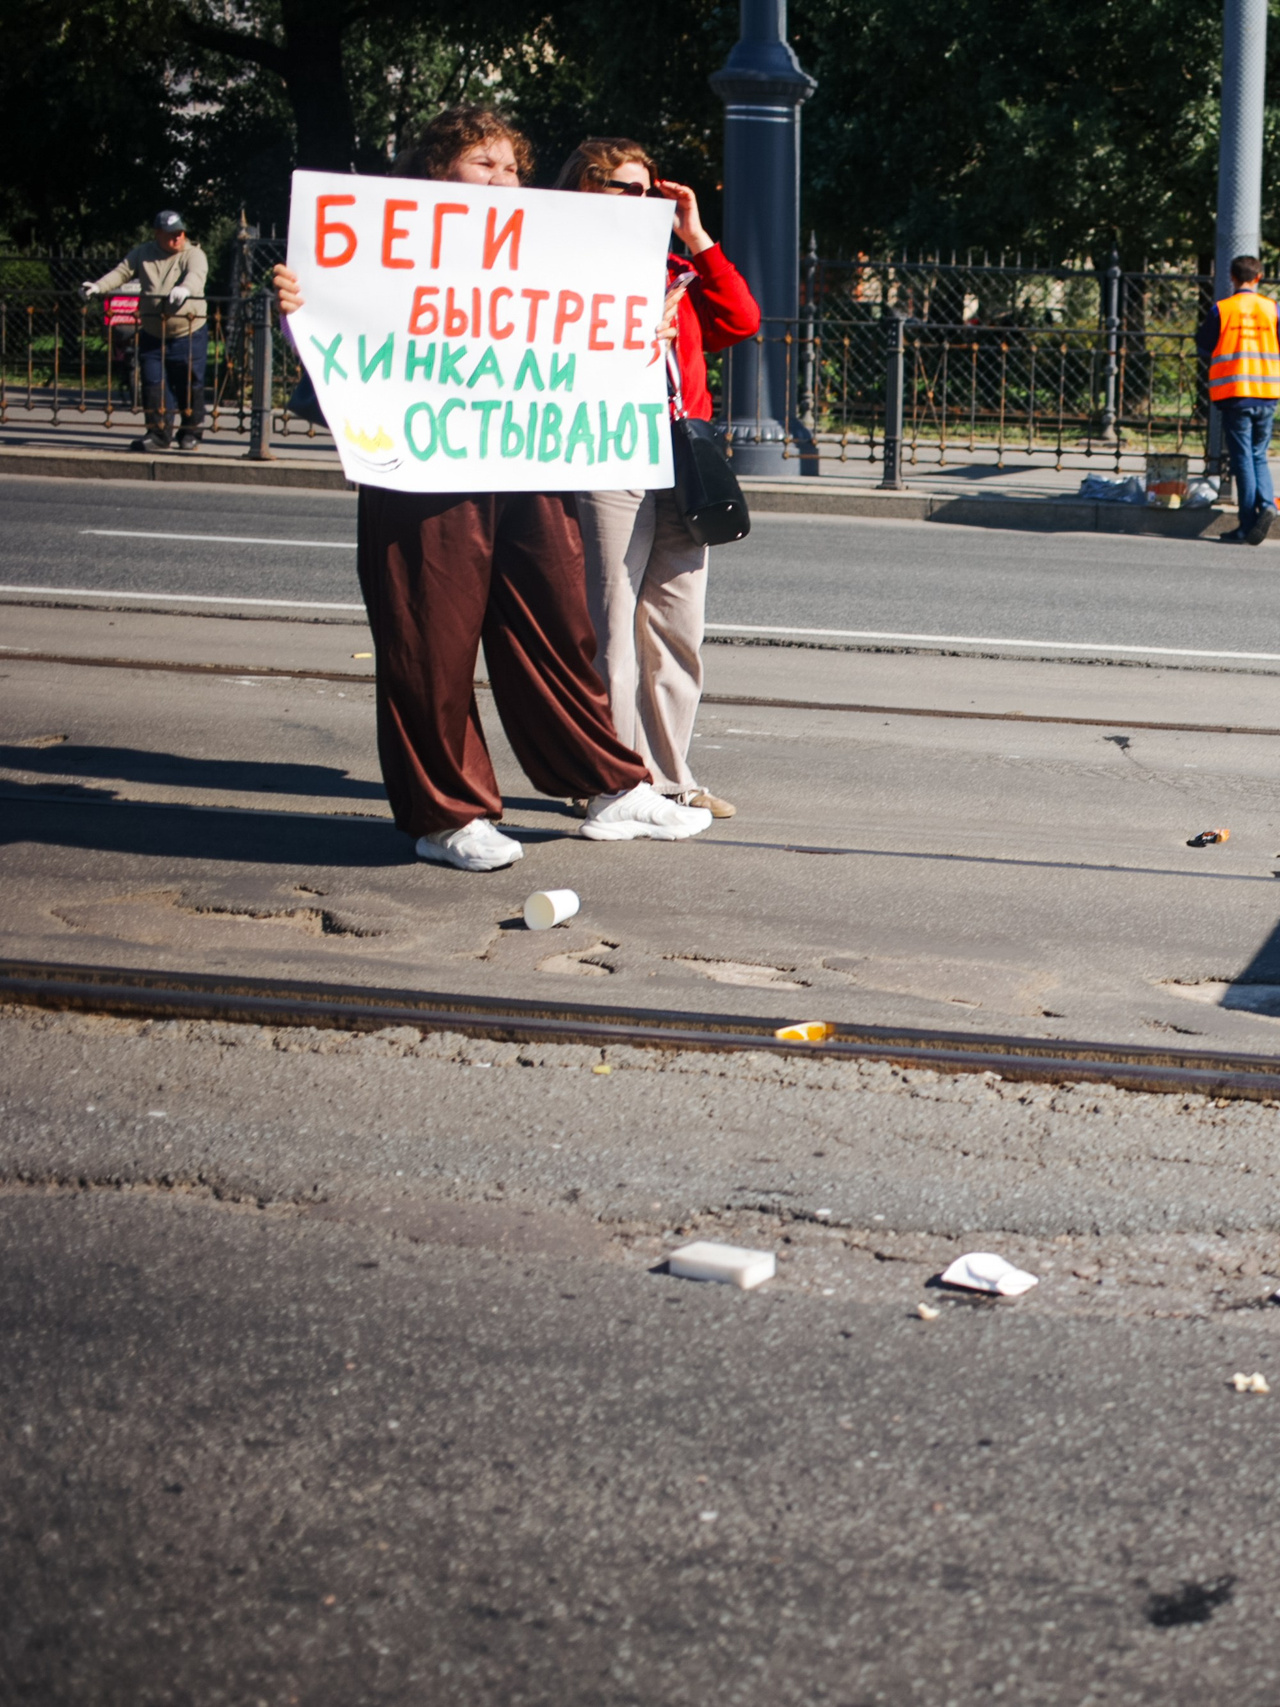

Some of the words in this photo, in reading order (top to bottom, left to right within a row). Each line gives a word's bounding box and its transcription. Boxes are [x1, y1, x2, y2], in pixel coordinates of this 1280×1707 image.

[314, 194, 525, 271] БЕГИ
[310, 332, 576, 393] ХИНКАЛИ
[408, 285, 661, 368] БЫСТРЕЕ,
[404, 397, 664, 465] ОСТЫВАЮТ
